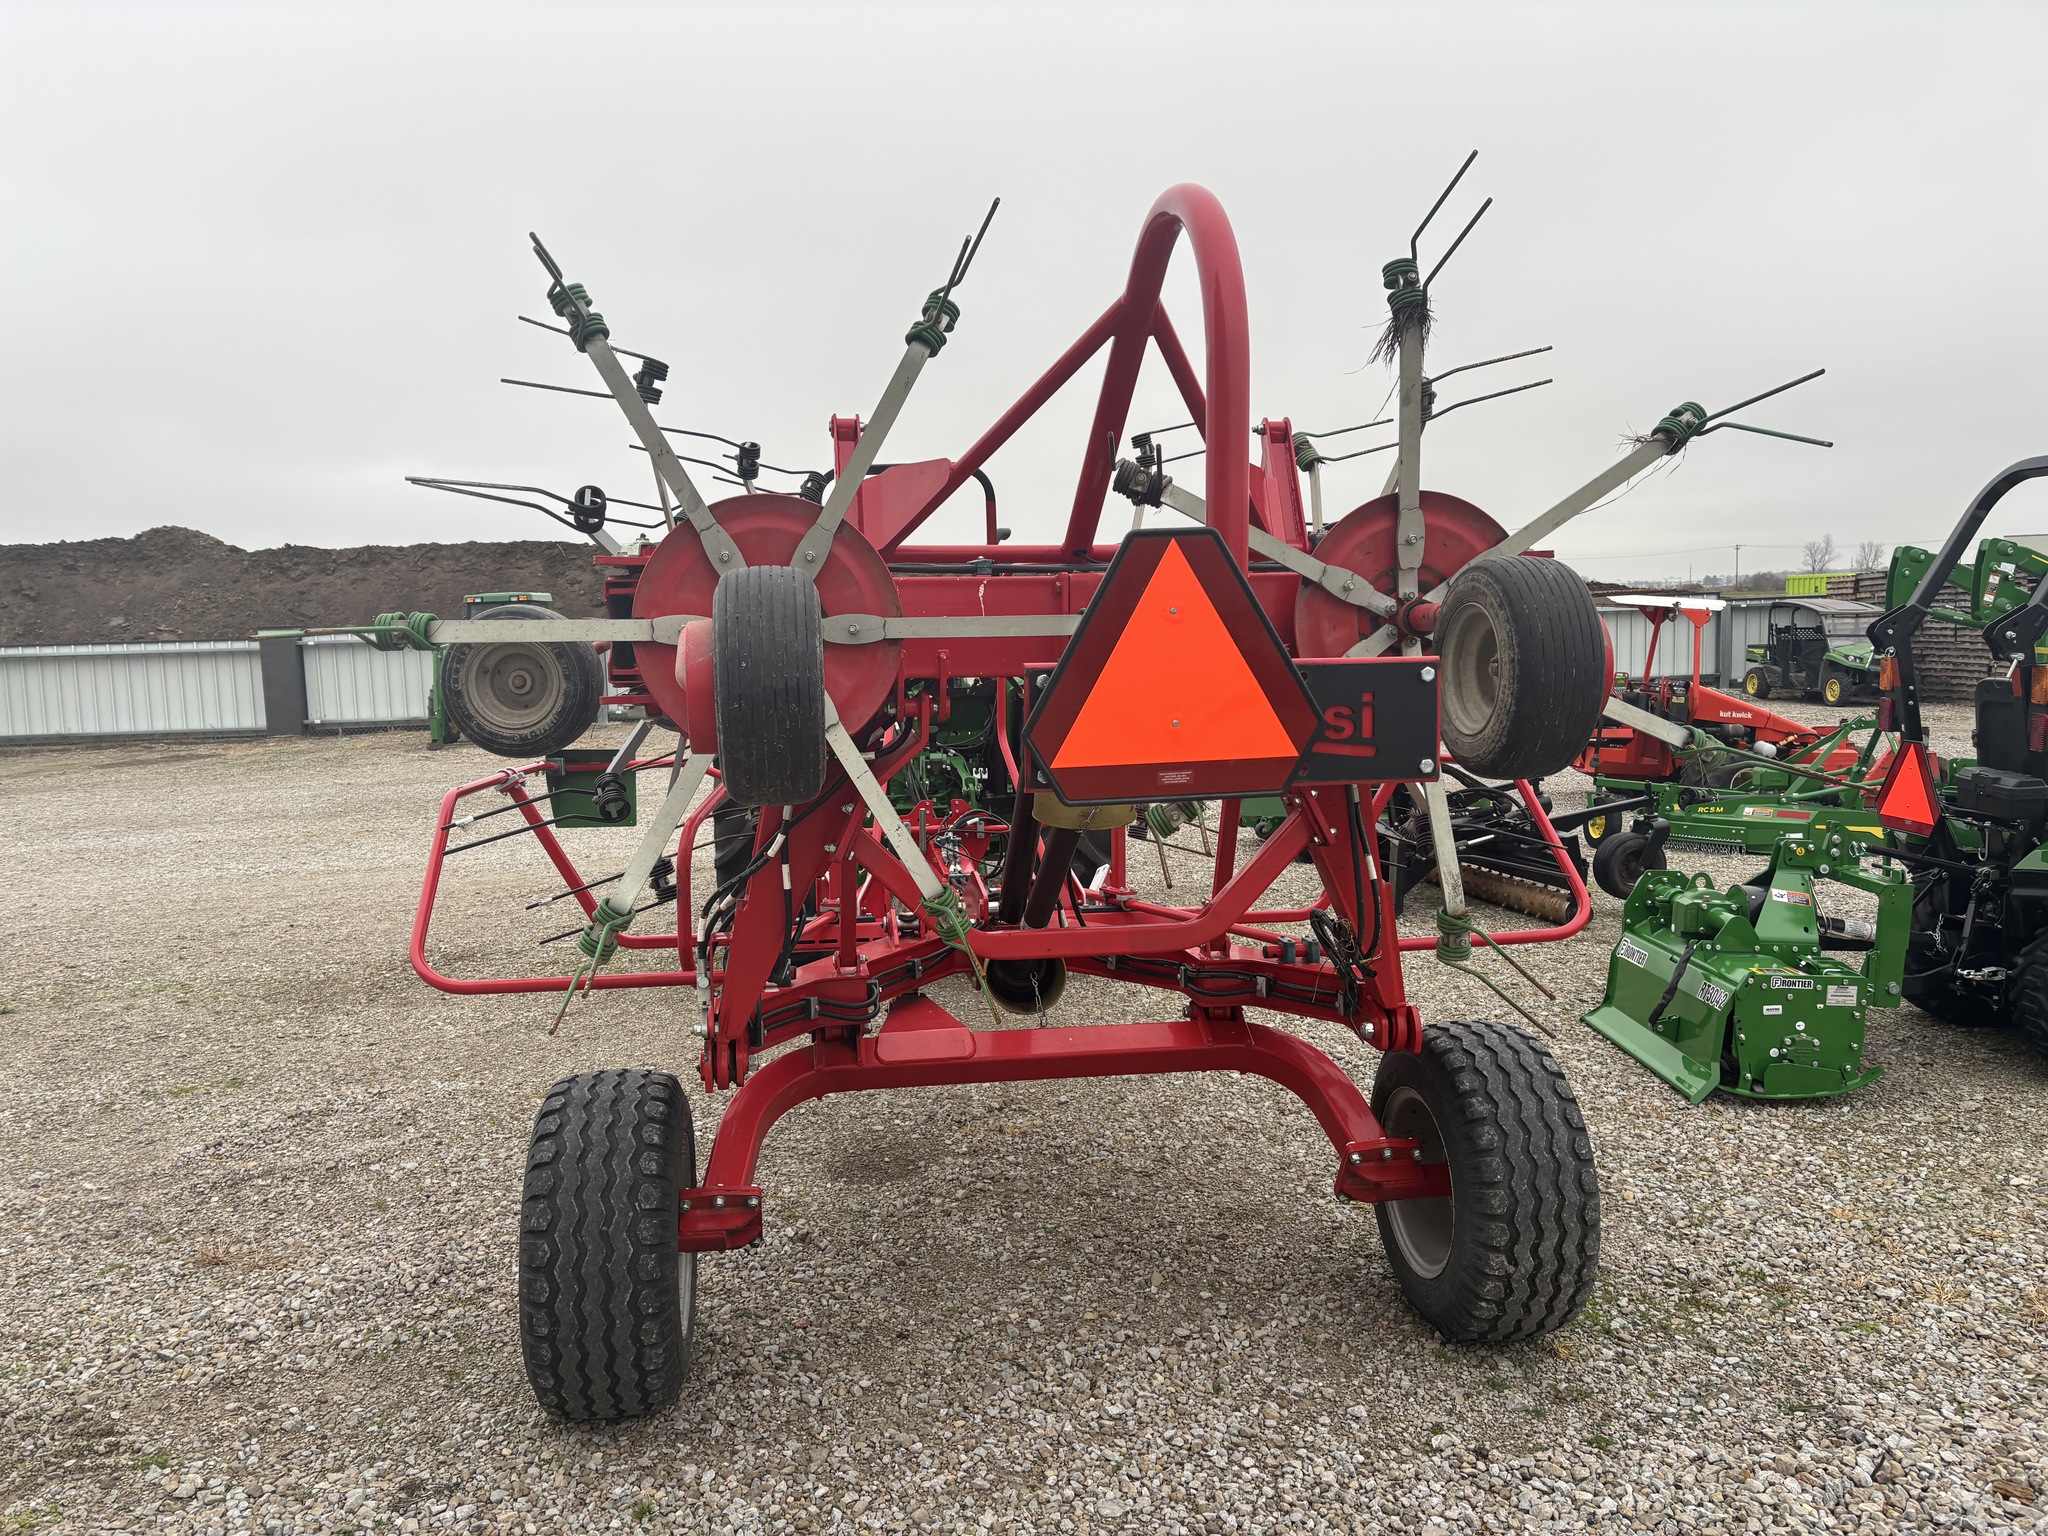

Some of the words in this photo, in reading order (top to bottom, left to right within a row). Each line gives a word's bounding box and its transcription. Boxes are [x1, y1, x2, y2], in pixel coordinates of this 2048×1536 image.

[1324, 691, 1374, 740] si
[1719, 710, 1731, 718] kut
[1732, 711, 1753, 719] kwick
[1617, 938, 1648, 968] FRONTIER
[1697, 981, 1729, 1010] RT3042
[1771, 976, 1813, 989] FRONTIER
